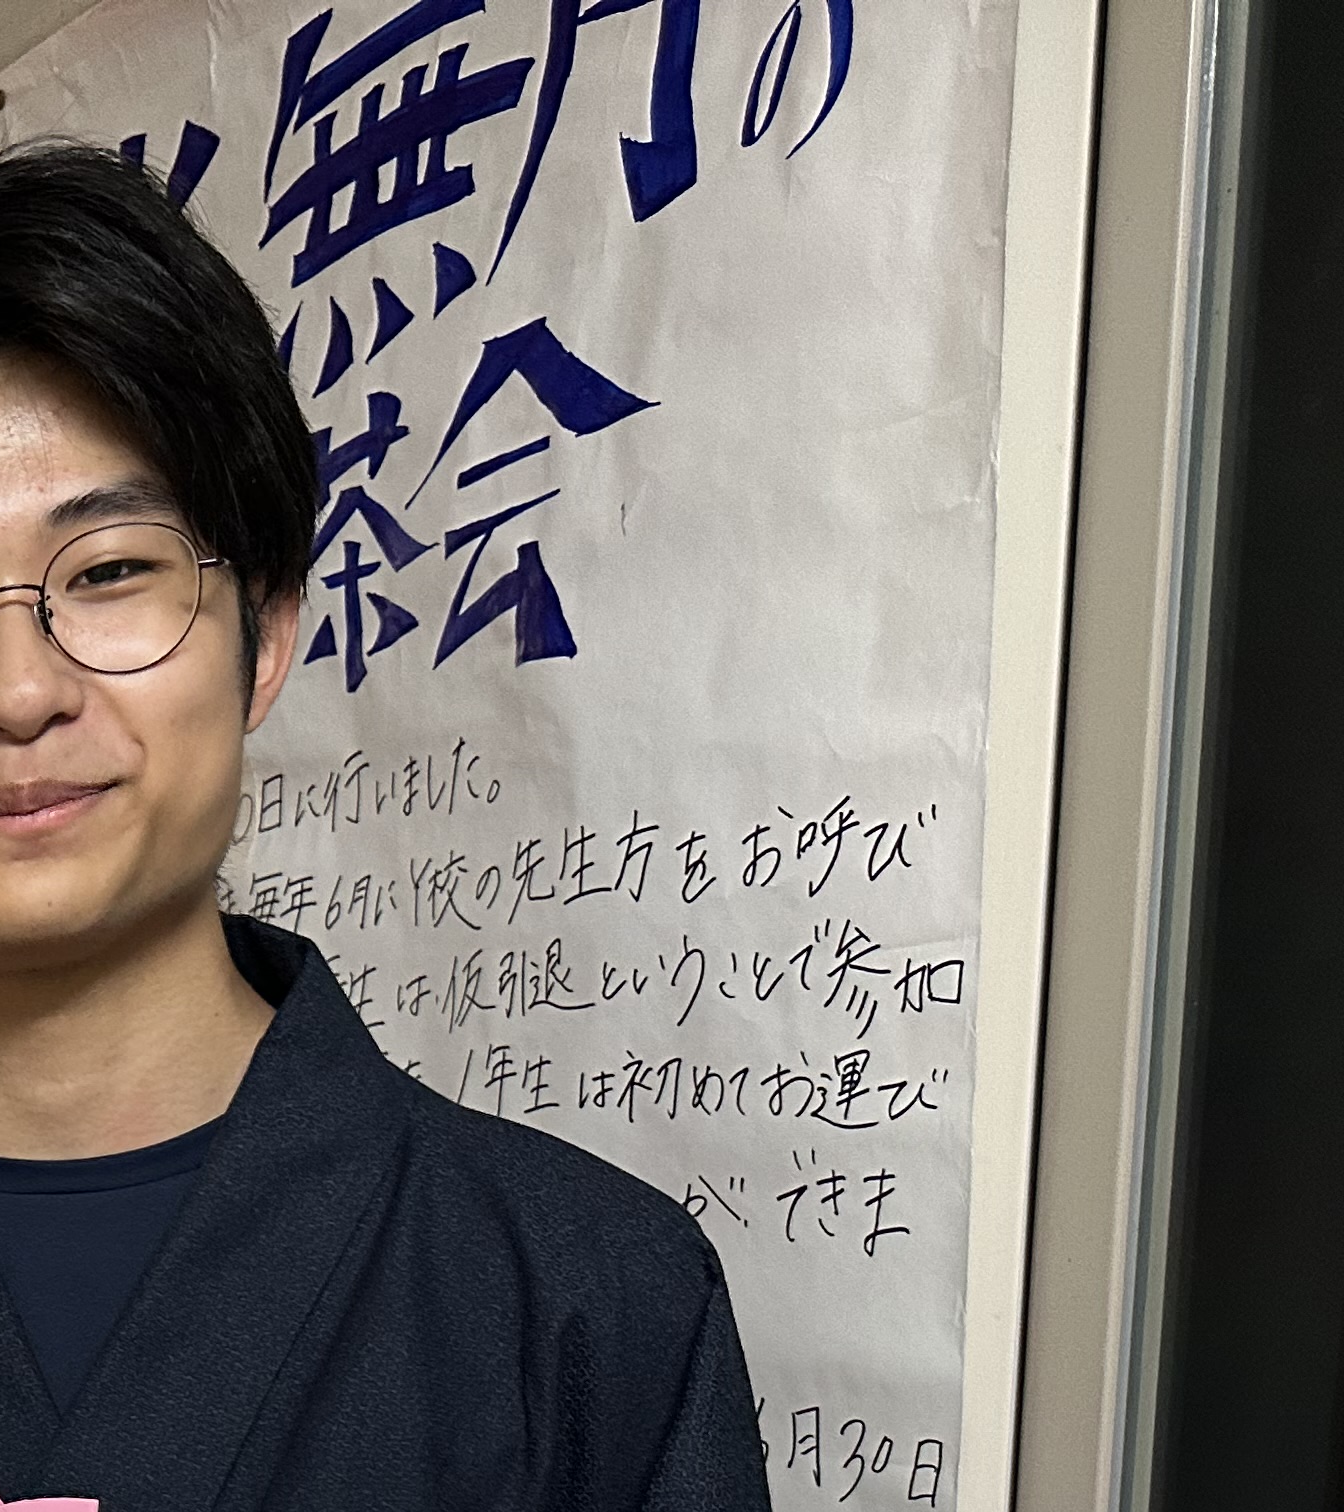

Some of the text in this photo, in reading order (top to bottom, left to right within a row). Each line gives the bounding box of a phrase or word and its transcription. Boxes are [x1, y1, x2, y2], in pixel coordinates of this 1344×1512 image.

[120, 0, 854, 398] 無月の
[755, 1397, 944, 1507] 月30日
